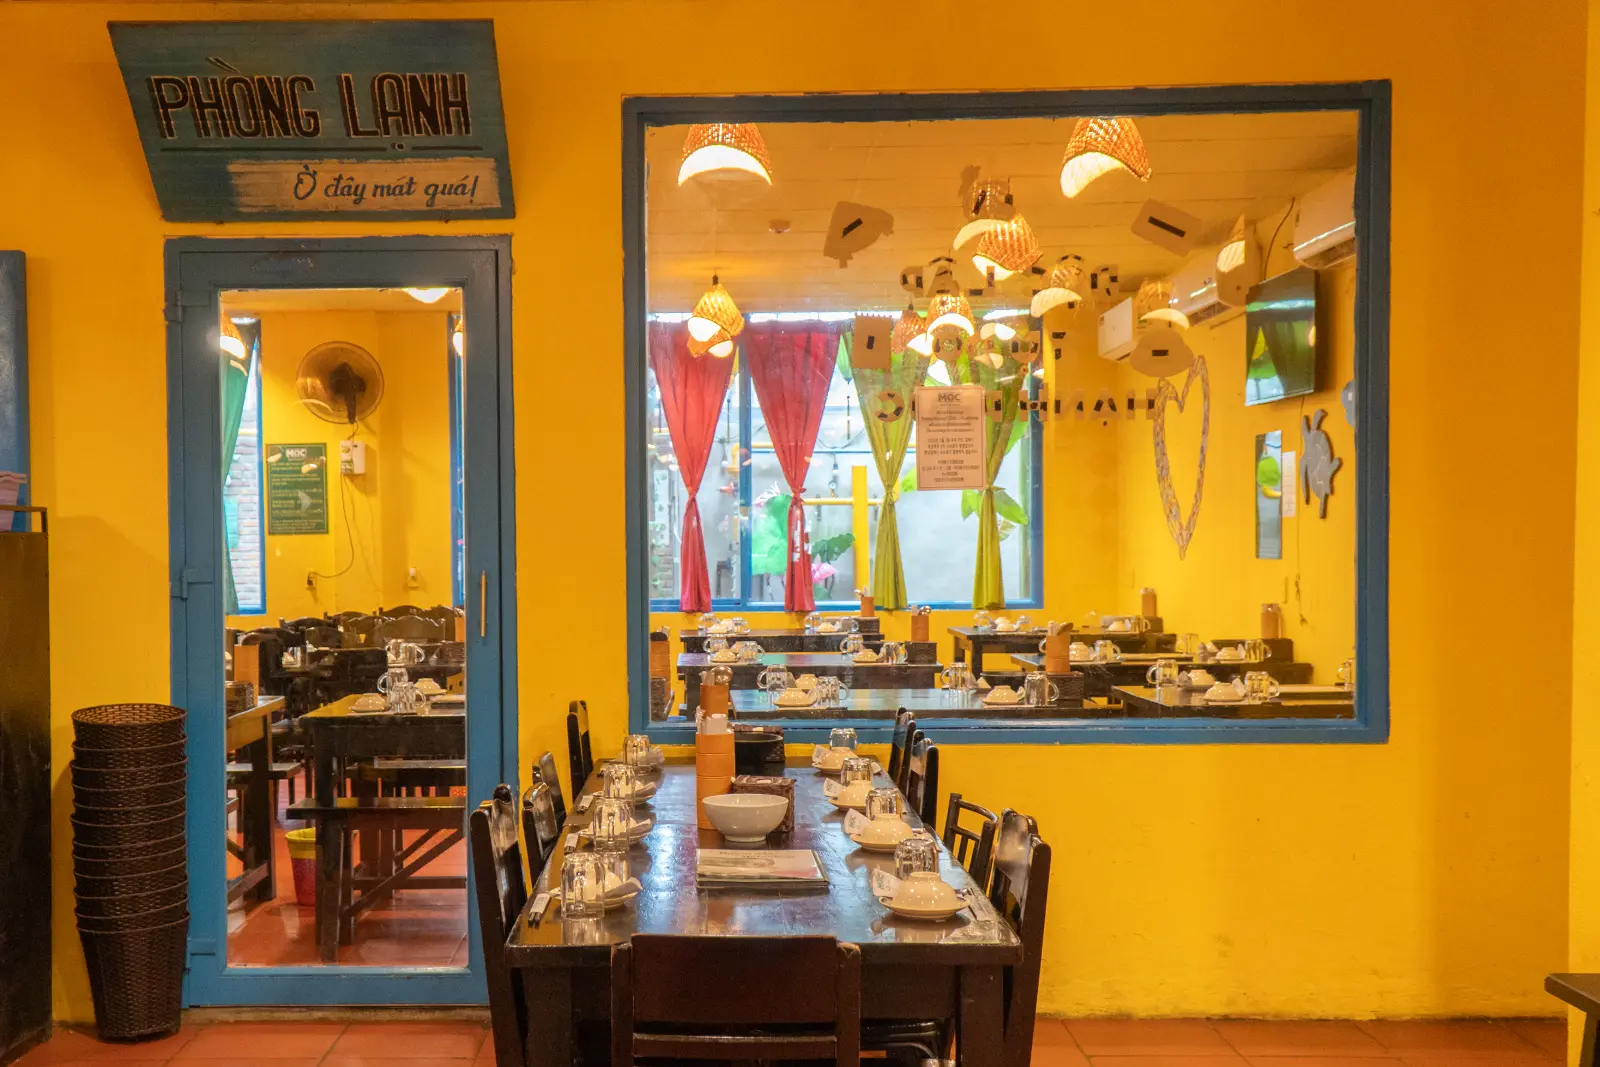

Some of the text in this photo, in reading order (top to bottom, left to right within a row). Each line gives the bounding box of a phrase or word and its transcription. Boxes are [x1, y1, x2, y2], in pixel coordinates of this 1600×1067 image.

[147, 56, 472, 150] PHÒNG LẠNH
[324, 173, 367, 204] đây
[372, 175, 417, 197] mát
[424, 174, 478, 207] quá!
